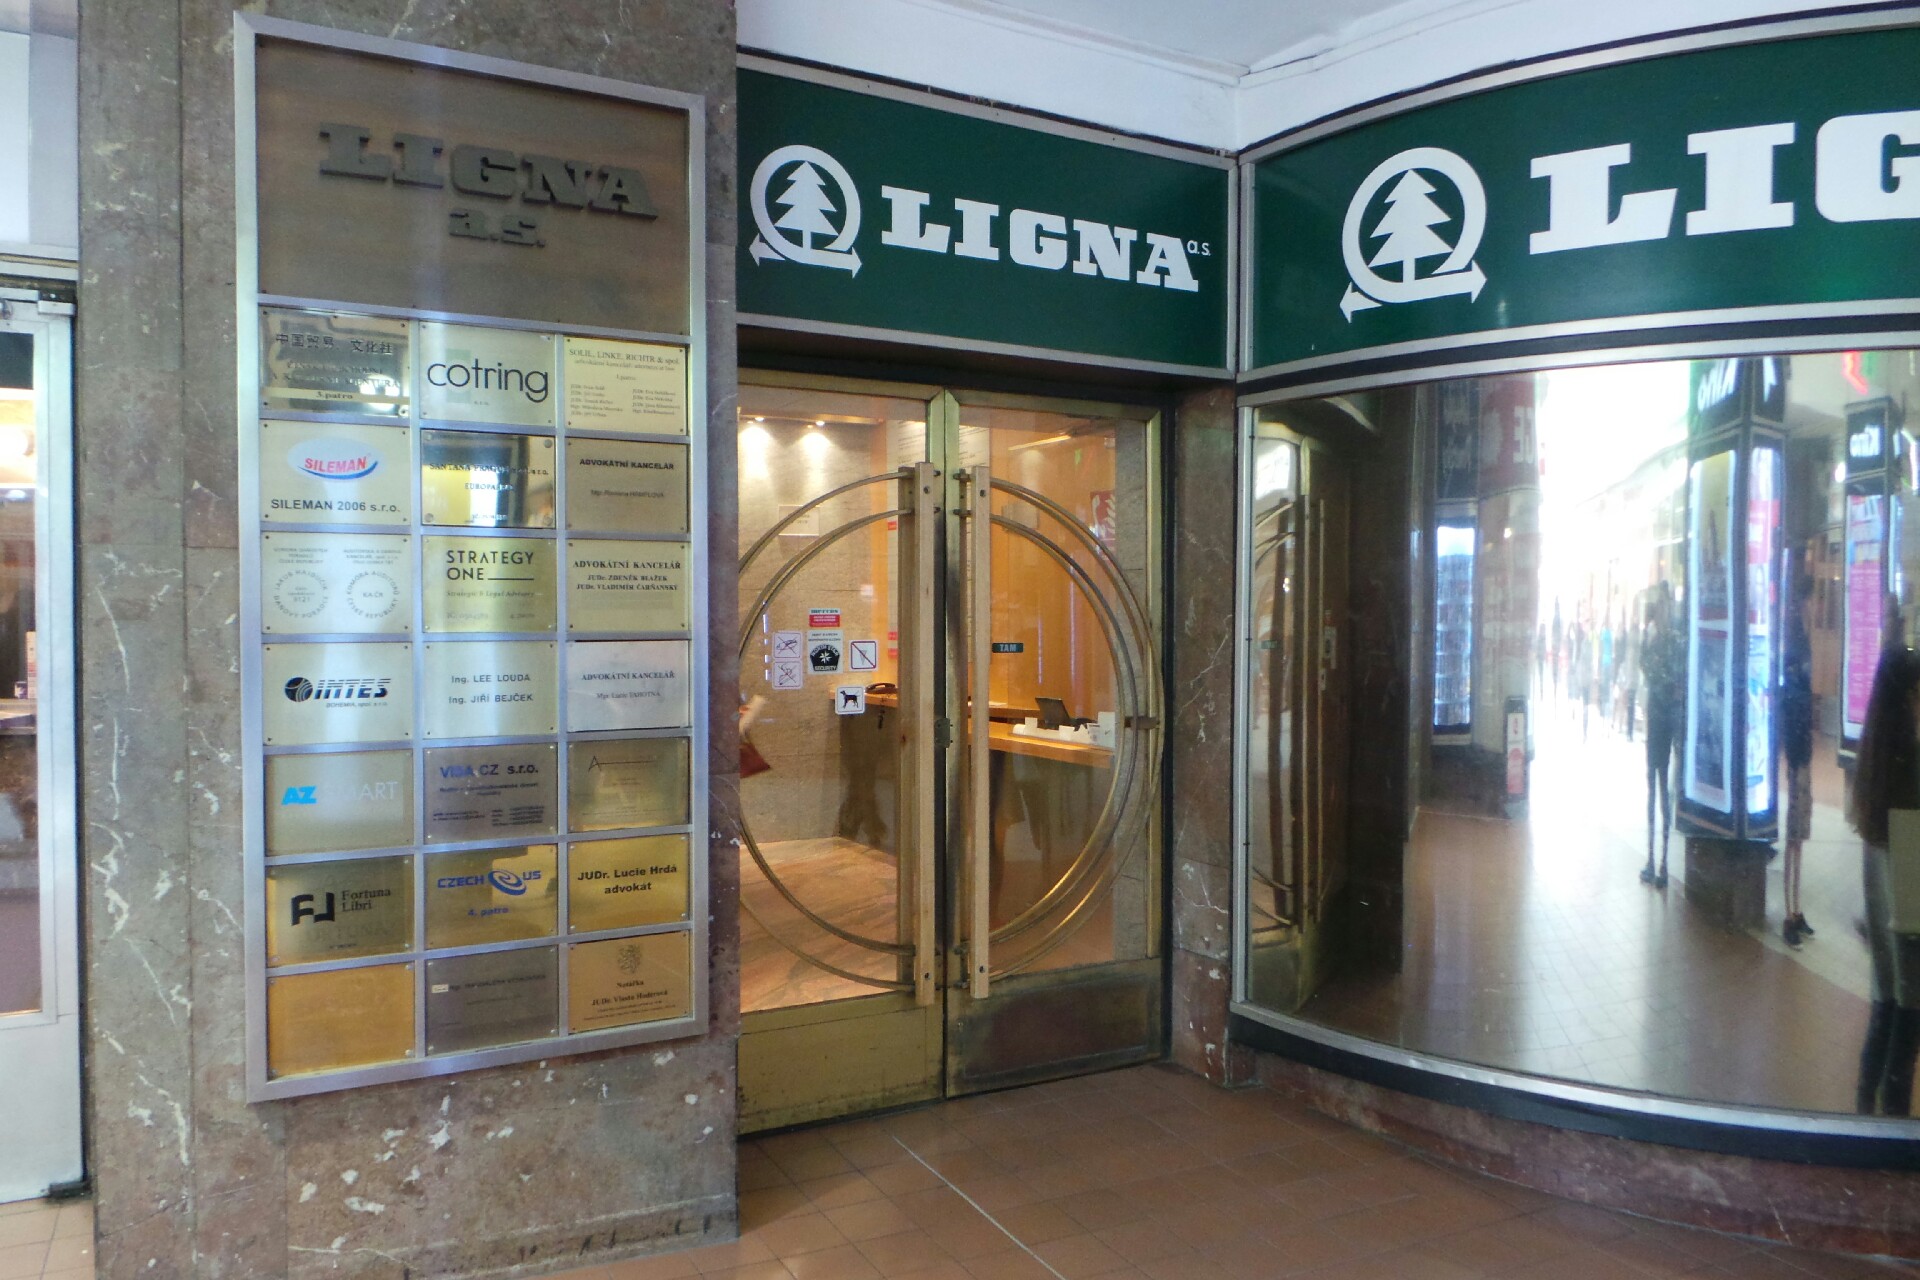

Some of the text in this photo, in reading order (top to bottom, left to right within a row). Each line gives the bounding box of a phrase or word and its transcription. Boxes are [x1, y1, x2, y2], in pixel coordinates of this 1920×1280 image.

[319, 122, 659, 220] LIGNA
[1530, 111, 1920, 255] LIG
[881, 185, 1199, 292] LIGNA
[427, 358, 549, 403] cotring
[304, 456, 367, 473] SILEMAN
[271, 499, 401, 513] SILEMAN 2006 s.r.o.
[447, 550, 534, 564] STRATEGY
[573, 560, 681, 570] ADVOKÁTNÍ KANCELÁŘ
[447, 567, 485, 581] ONE
[451, 675, 469, 684] Ing.
[497, 674, 531, 682] LOUDA
[582, 671, 630, 681] ADVOKÁTNÍ
[314, 678, 391, 700] INTES
[448, 693, 534, 705] Ing. JIŘÍ BEJČEK
[479, 764, 499, 775] CZ
[507, 764, 539, 775] s.r.o.
[281, 785, 318, 805] AZ
[437, 870, 542, 888] CZECH US
[577, 864, 677, 880] JUDr. Lucie Hrdá
[341, 888, 391, 900] Fortuna
[604, 882, 652, 894] advokát
[341, 900, 372, 912] Libri
